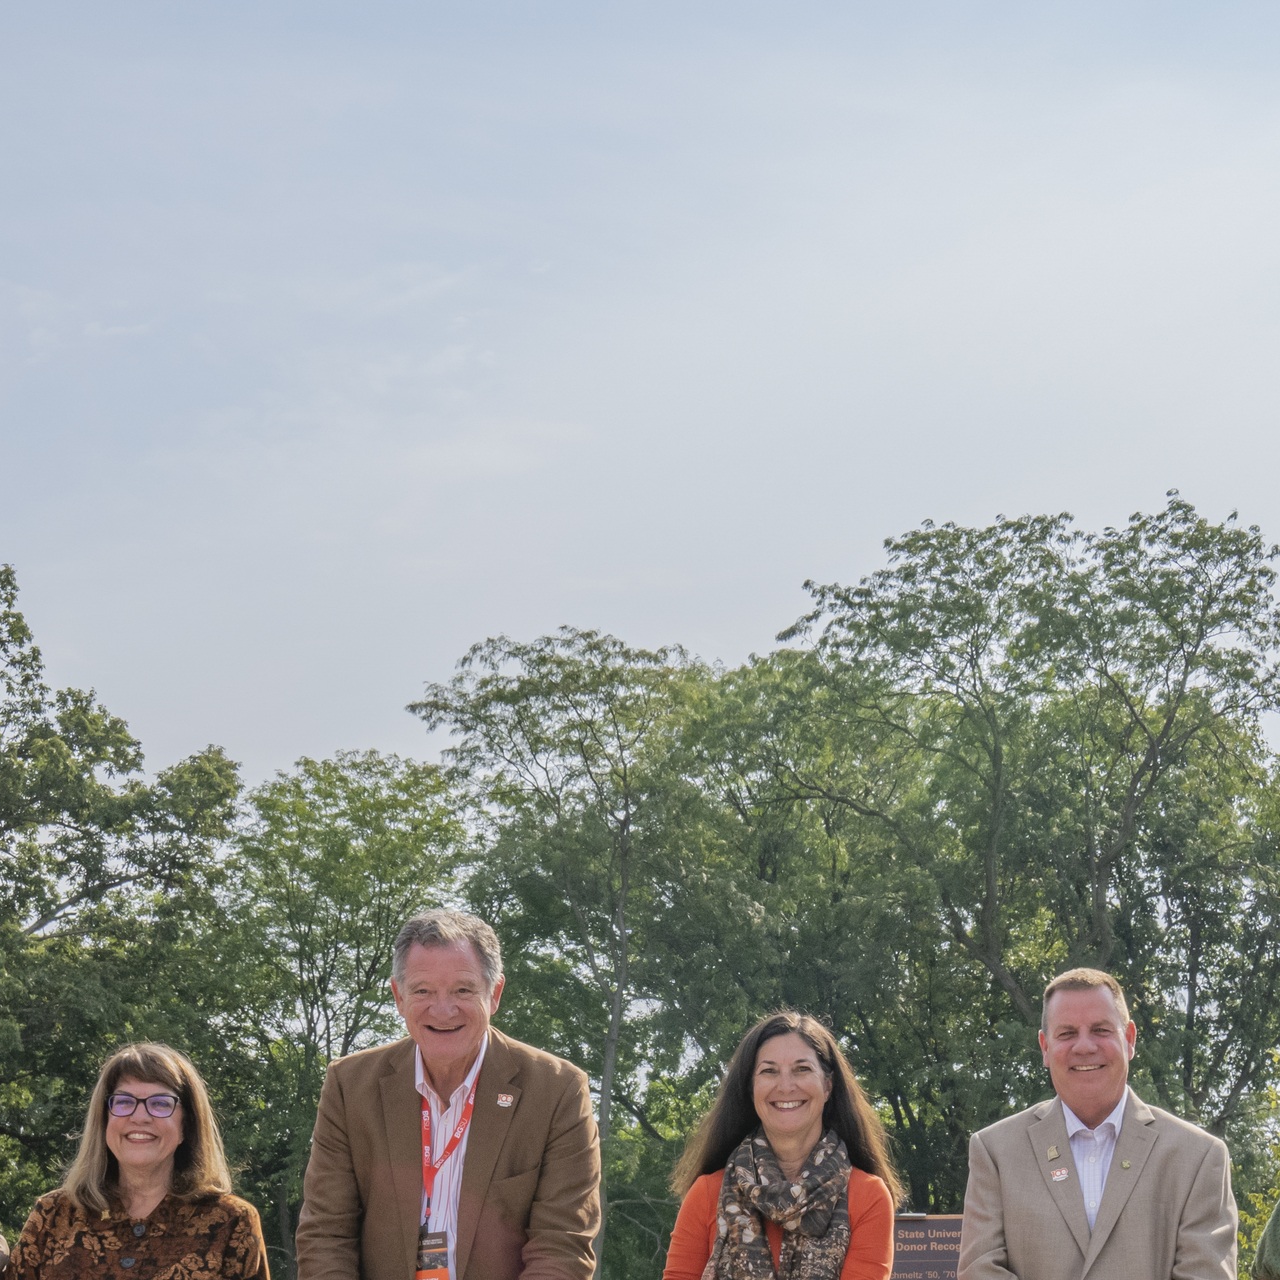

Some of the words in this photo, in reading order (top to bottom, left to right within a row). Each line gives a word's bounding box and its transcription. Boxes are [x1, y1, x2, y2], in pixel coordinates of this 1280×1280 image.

[422, 1110, 430, 1130] BGSU
[454, 1117, 468, 1139] BGSU
[897, 1229, 925, 1239] State
[896, 1242, 927, 1252] Donor
